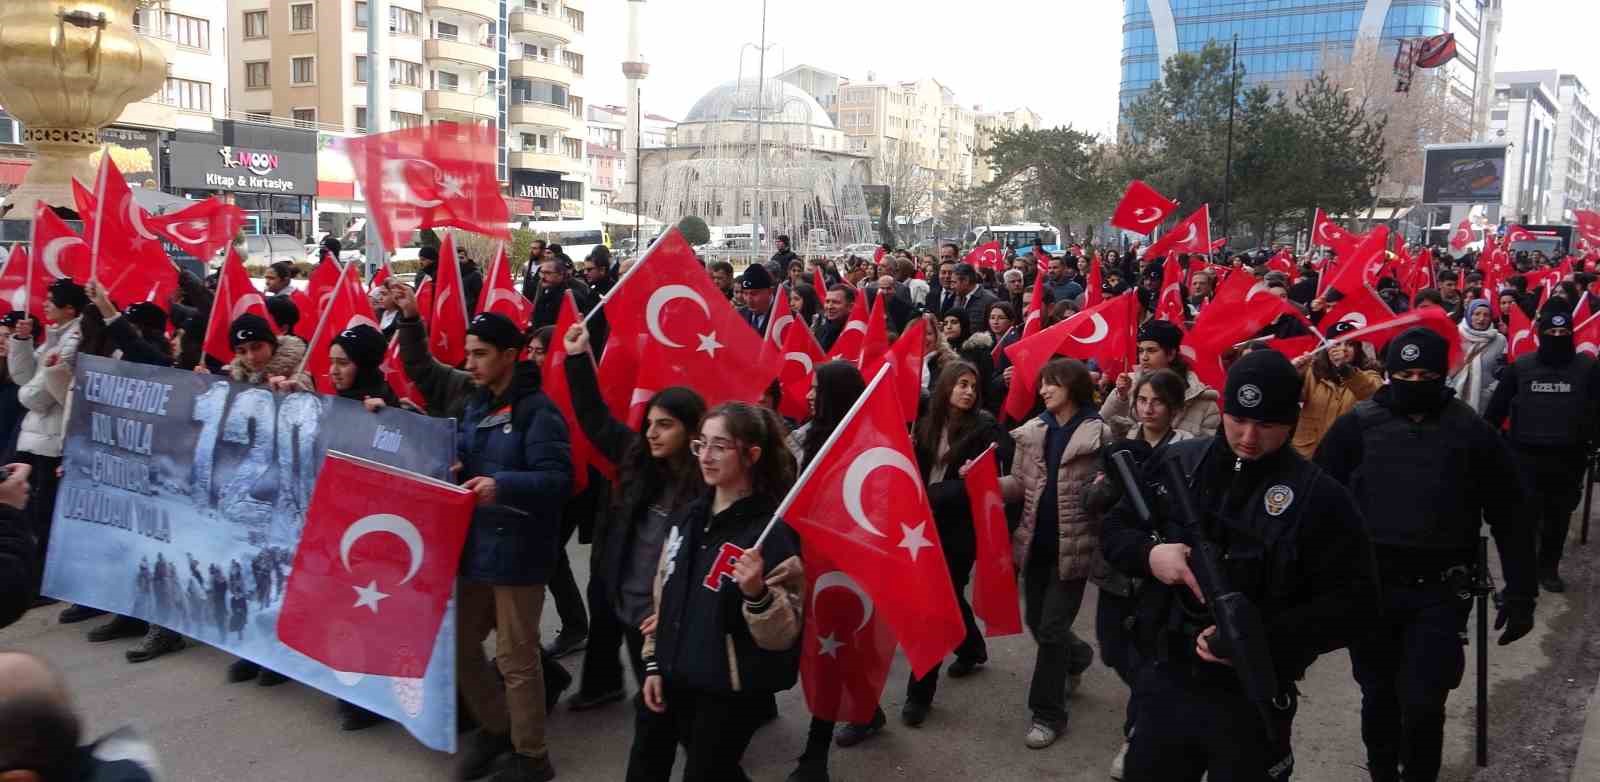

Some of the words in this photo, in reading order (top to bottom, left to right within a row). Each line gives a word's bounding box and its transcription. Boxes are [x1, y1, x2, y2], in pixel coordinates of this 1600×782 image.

[239, 151, 278, 169] MOON
[206, 173, 235, 188] Kitap
[238, 175, 247, 187] &
[249, 176, 294, 192] Kırtasiye
[520, 183, 559, 199] ARMİNE
[191, 380, 323, 525] 120
